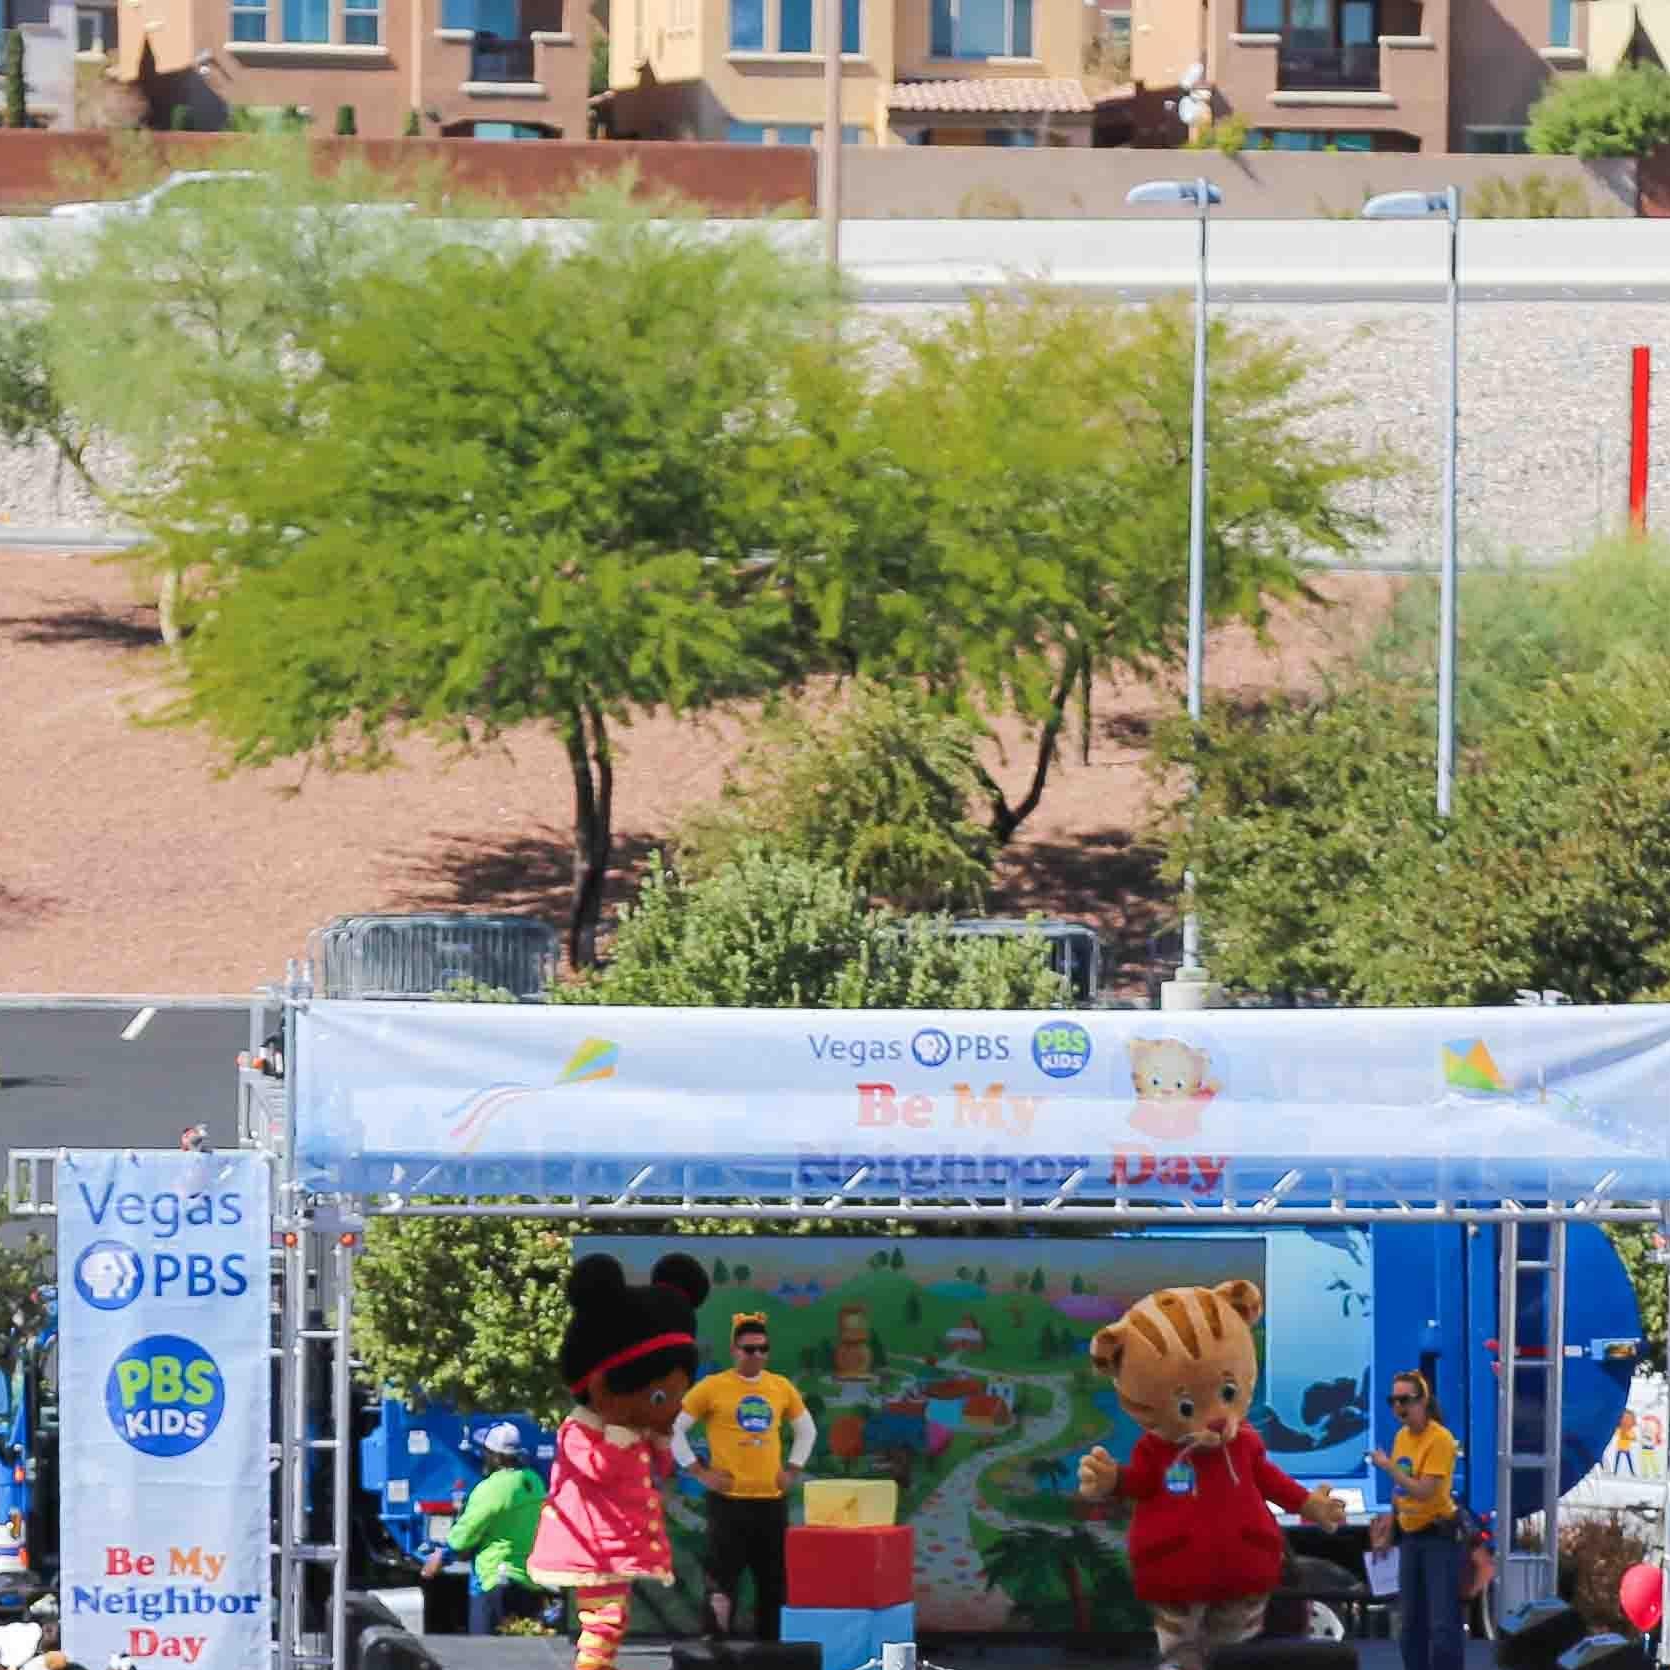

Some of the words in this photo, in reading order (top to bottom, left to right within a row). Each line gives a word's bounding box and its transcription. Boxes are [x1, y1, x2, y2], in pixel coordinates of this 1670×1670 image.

[809, 1033, 902, 1067] Vegas
[957, 1035, 1010, 1060] PBS
[1033, 1027, 1088, 1056] PBS
[1041, 1053, 1084, 1072] KIDS
[856, 1082, 932, 1128] Be
[951, 1082, 1047, 1135] My
[794, 1144, 1089, 1196] Neighbor
[1107, 1145, 1228, 1195] Day
[80, 1182, 242, 1238] Vegas
[155, 1254, 248, 1297] PBS
[115, 1356, 216, 1408] PBS
[124, 1409, 208, 1439] KIDS
[105, 1547, 155, 1576] Be
[169, 1547, 226, 1582] My
[71, 1585, 263, 1621] Neighbor
[126, 1628, 208, 1663] Day
